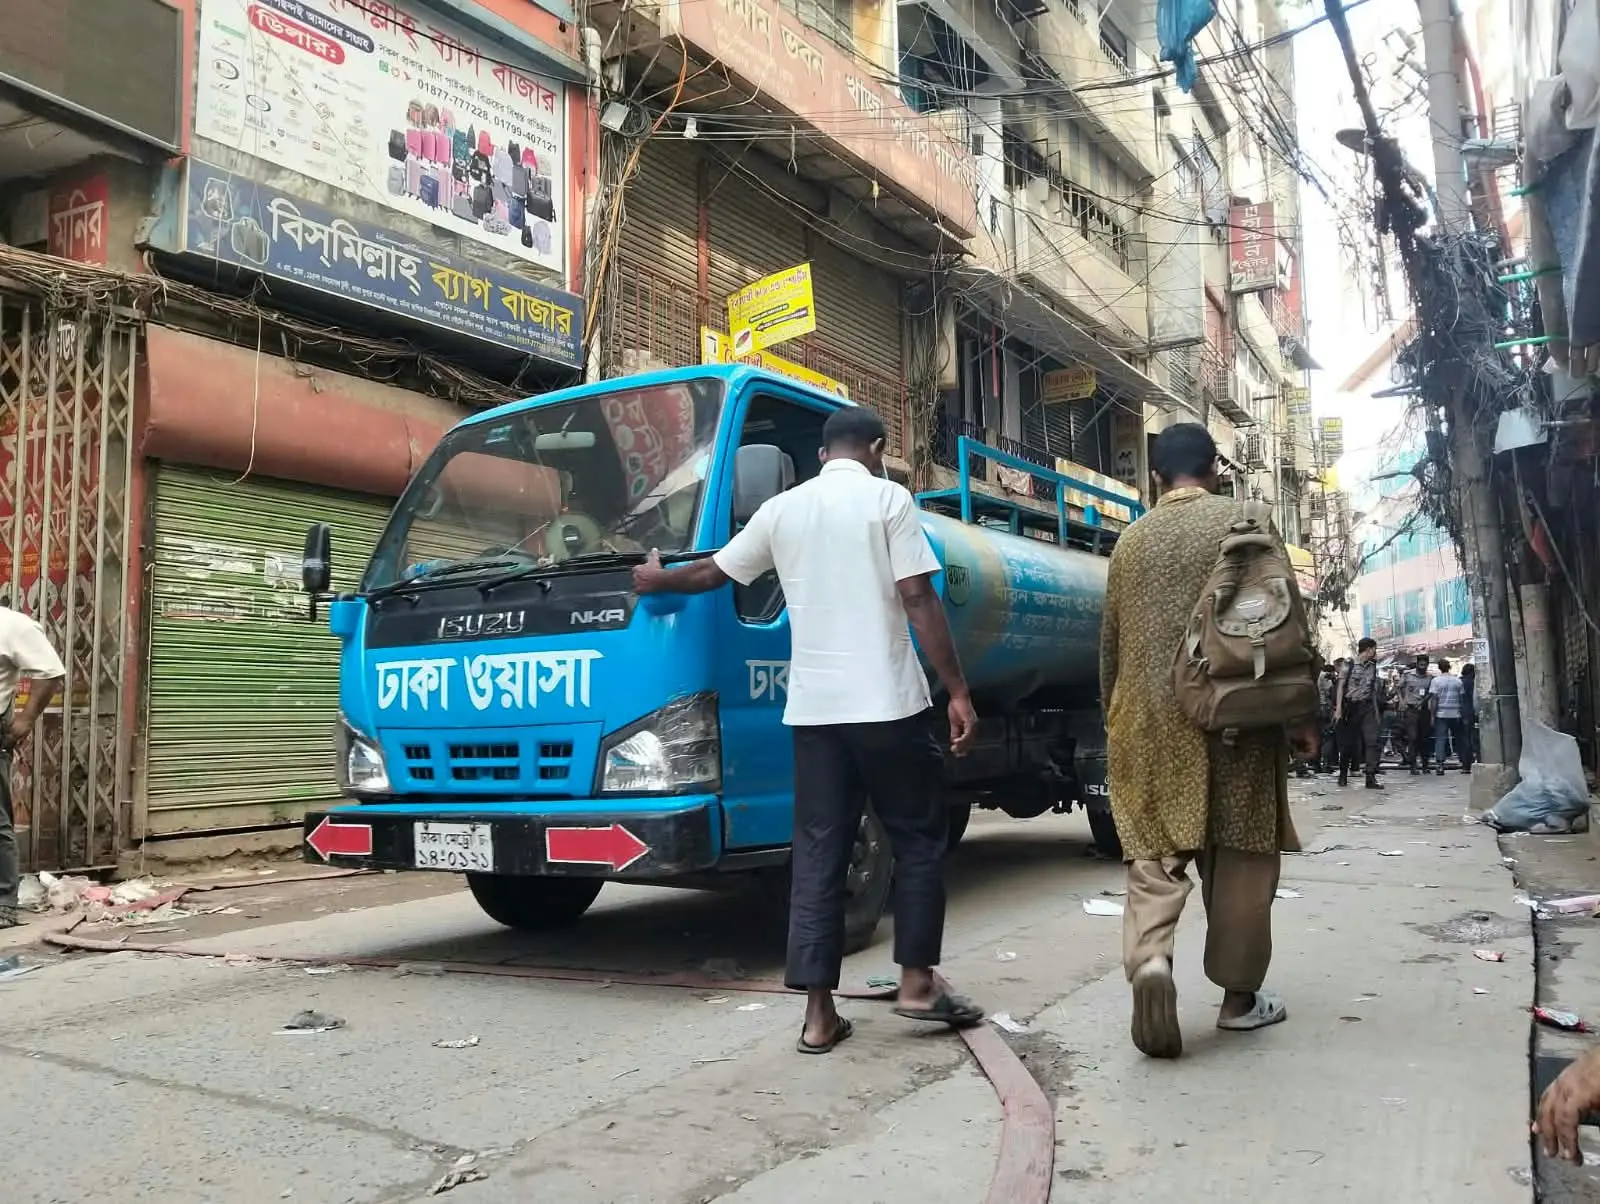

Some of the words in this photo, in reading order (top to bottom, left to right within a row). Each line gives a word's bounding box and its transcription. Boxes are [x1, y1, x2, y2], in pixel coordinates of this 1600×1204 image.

[492, 62, 557, 117] বাজার
[428, 261, 493, 311] ব্যাগ
[497, 285, 575, 337] বাজার
[437, 610, 525, 639] ISUZU
[570, 608, 625, 625] NKR
[375, 657, 458, 711] ঢাকা
[463, 649, 605, 711] ওয়াসা
